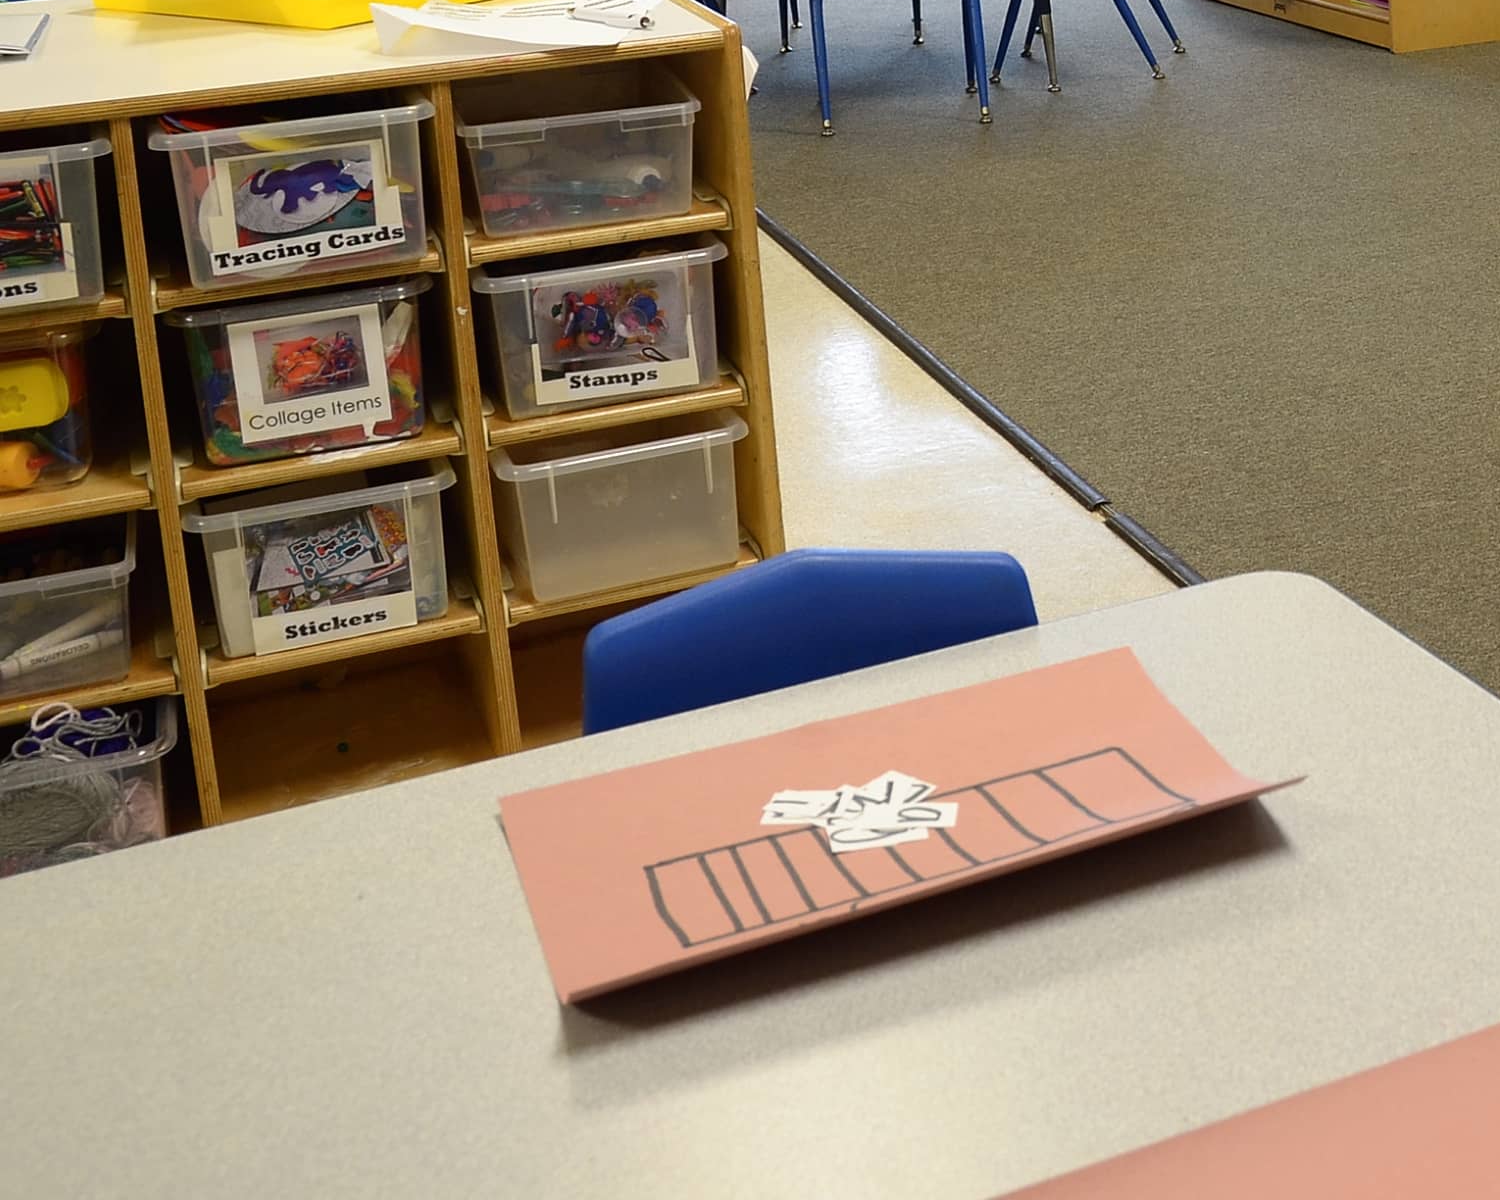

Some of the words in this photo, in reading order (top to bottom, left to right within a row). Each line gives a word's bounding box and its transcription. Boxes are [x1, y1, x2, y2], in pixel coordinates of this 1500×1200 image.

[214, 240, 321, 270] Tracing
[327, 226, 404, 249] Cards
[0, 281, 38, 298] ns
[569, 369, 658, 390] Stamps
[249, 405, 326, 430] Collage
[331, 395, 382, 416] Items
[285, 607, 388, 640] Stickers
